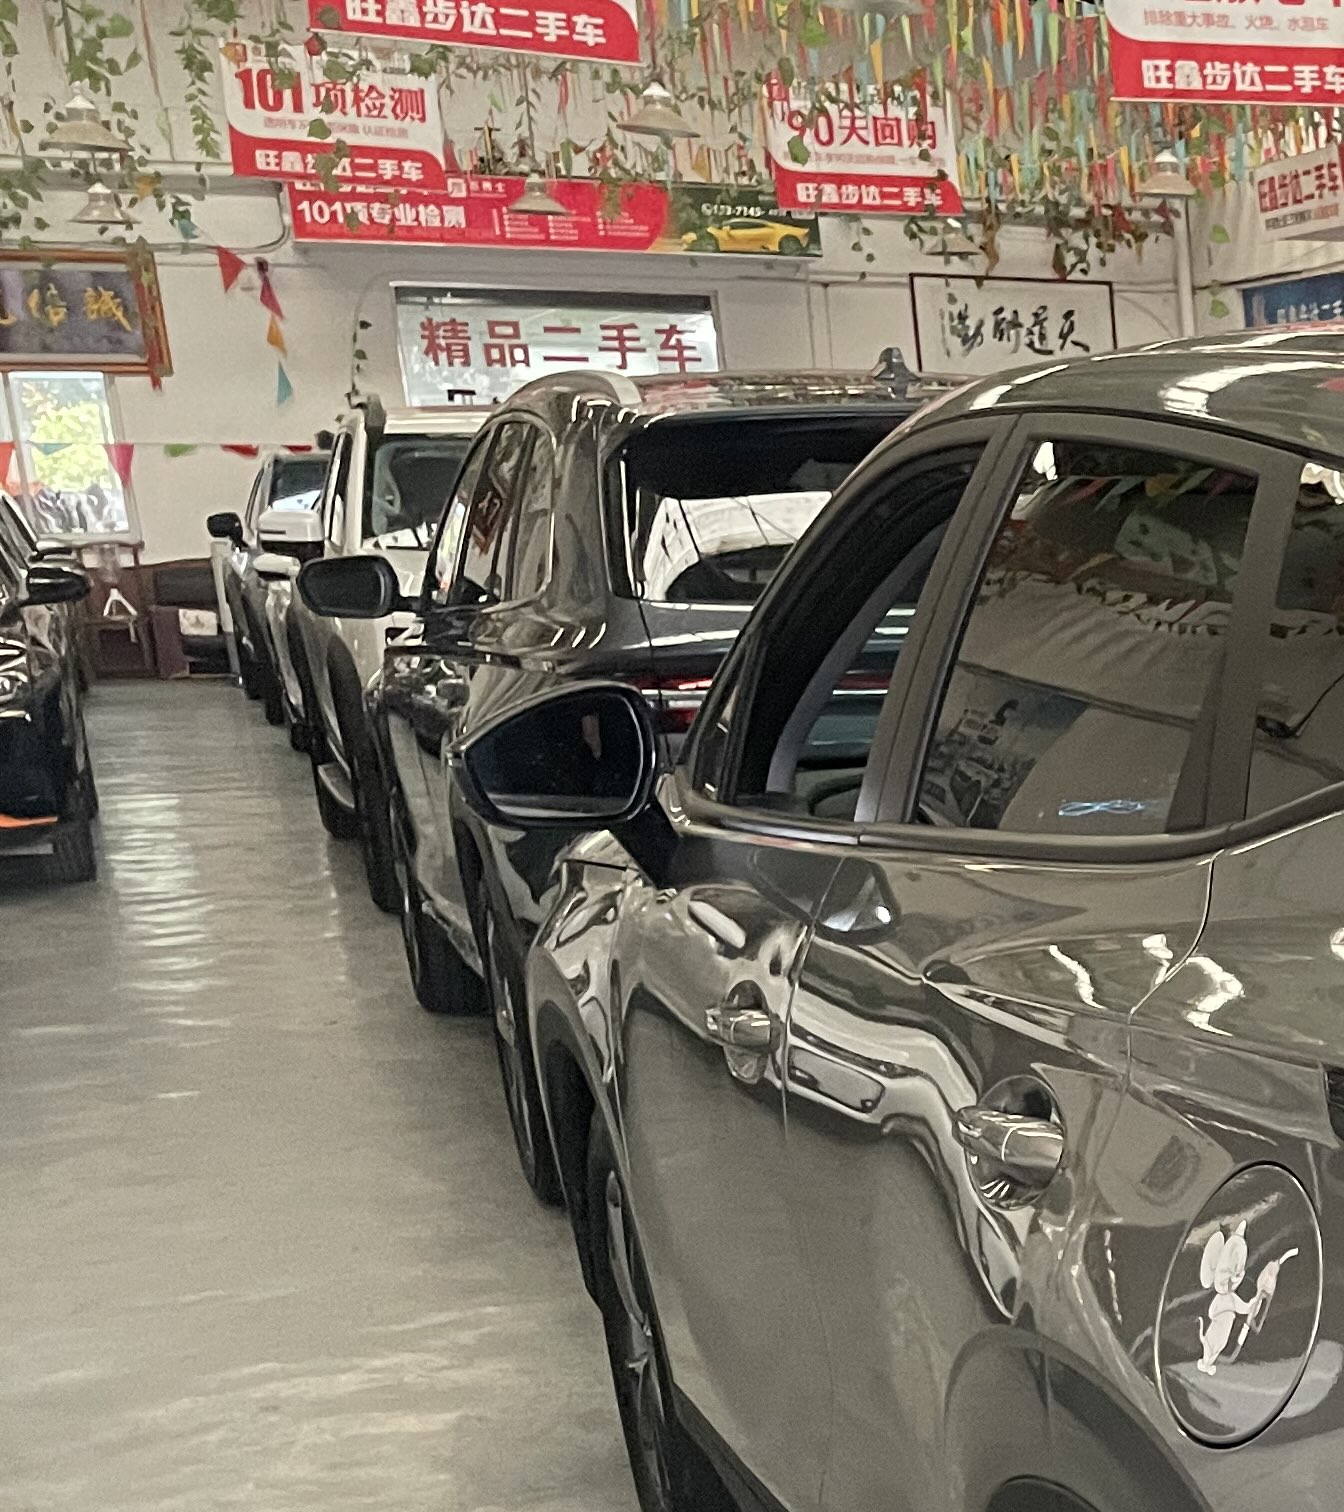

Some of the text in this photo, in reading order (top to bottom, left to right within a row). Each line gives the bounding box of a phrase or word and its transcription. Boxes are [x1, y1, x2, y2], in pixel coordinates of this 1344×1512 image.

[346, 0, 606, 46] 旺鑫步达二手车
[420, 316, 703, 373] 精品二手车
